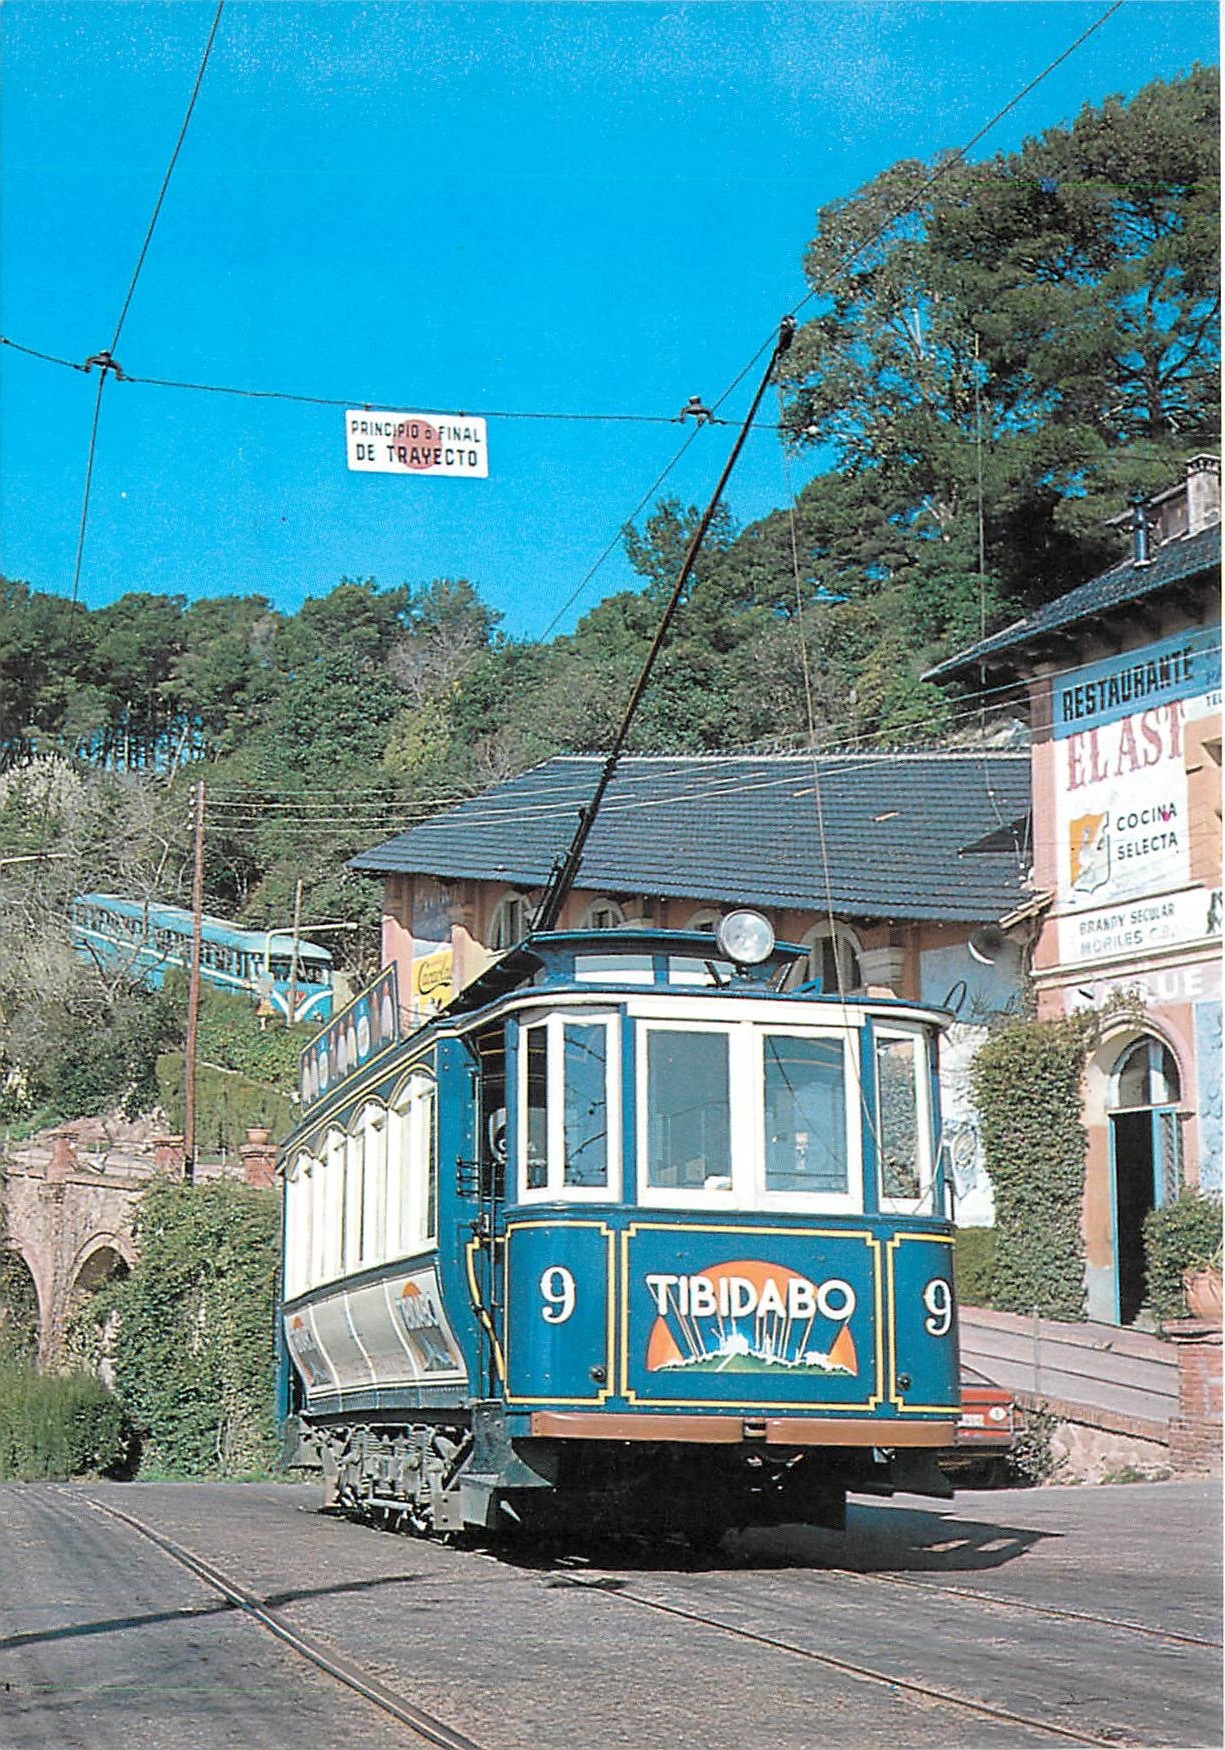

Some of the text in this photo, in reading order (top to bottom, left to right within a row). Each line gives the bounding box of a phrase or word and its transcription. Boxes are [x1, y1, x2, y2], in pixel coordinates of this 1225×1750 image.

[351, 420, 419, 439] PRINCIPIO
[438, 426, 481, 443] FINAL
[356, 443, 478, 467] DE TRAYECTO
[1062, 645, 1194, 722] RESTAURANTE
[1116, 802, 1178, 832] COCINA
[1116, 831, 1178, 860] SELECTA
[1079, 902, 1175, 936] BRANDY SECULAR
[540, 1265, 576, 1324] 9
[645, 1274, 857, 1321] TIBIDABO
[922, 1279, 952, 1336] 9
